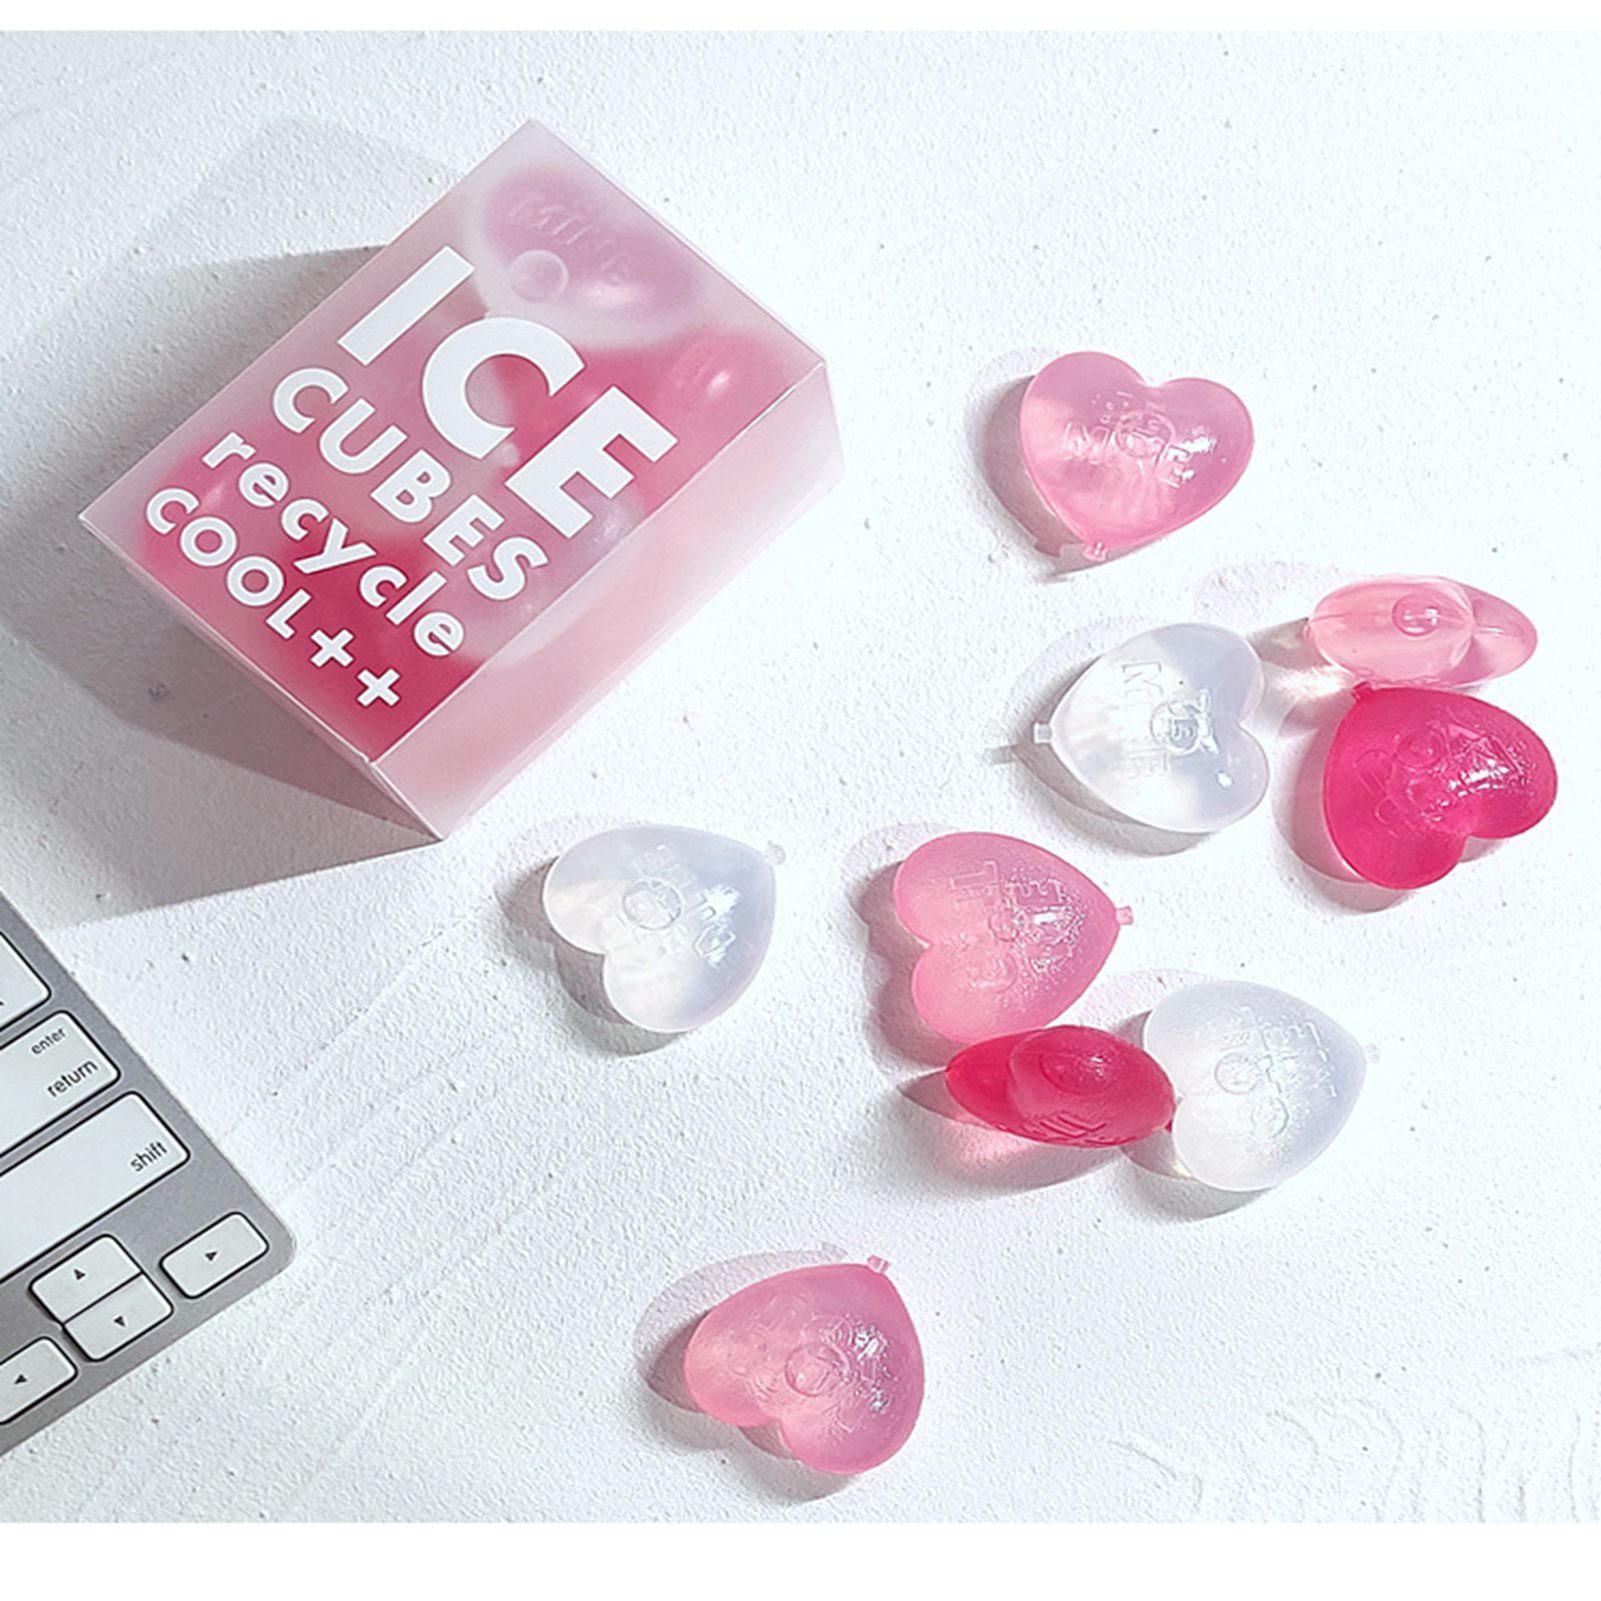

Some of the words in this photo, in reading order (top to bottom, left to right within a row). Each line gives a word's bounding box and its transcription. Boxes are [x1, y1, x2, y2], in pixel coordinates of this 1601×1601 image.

[337, 245, 678, 538] ICE
[202, 431, 466, 657] recycle
[272, 367, 548, 600] CUBES
[31, 1028, 66, 1055] enter
[47, 1060, 98, 1097] return
[131, 1140, 168, 1172] shift
